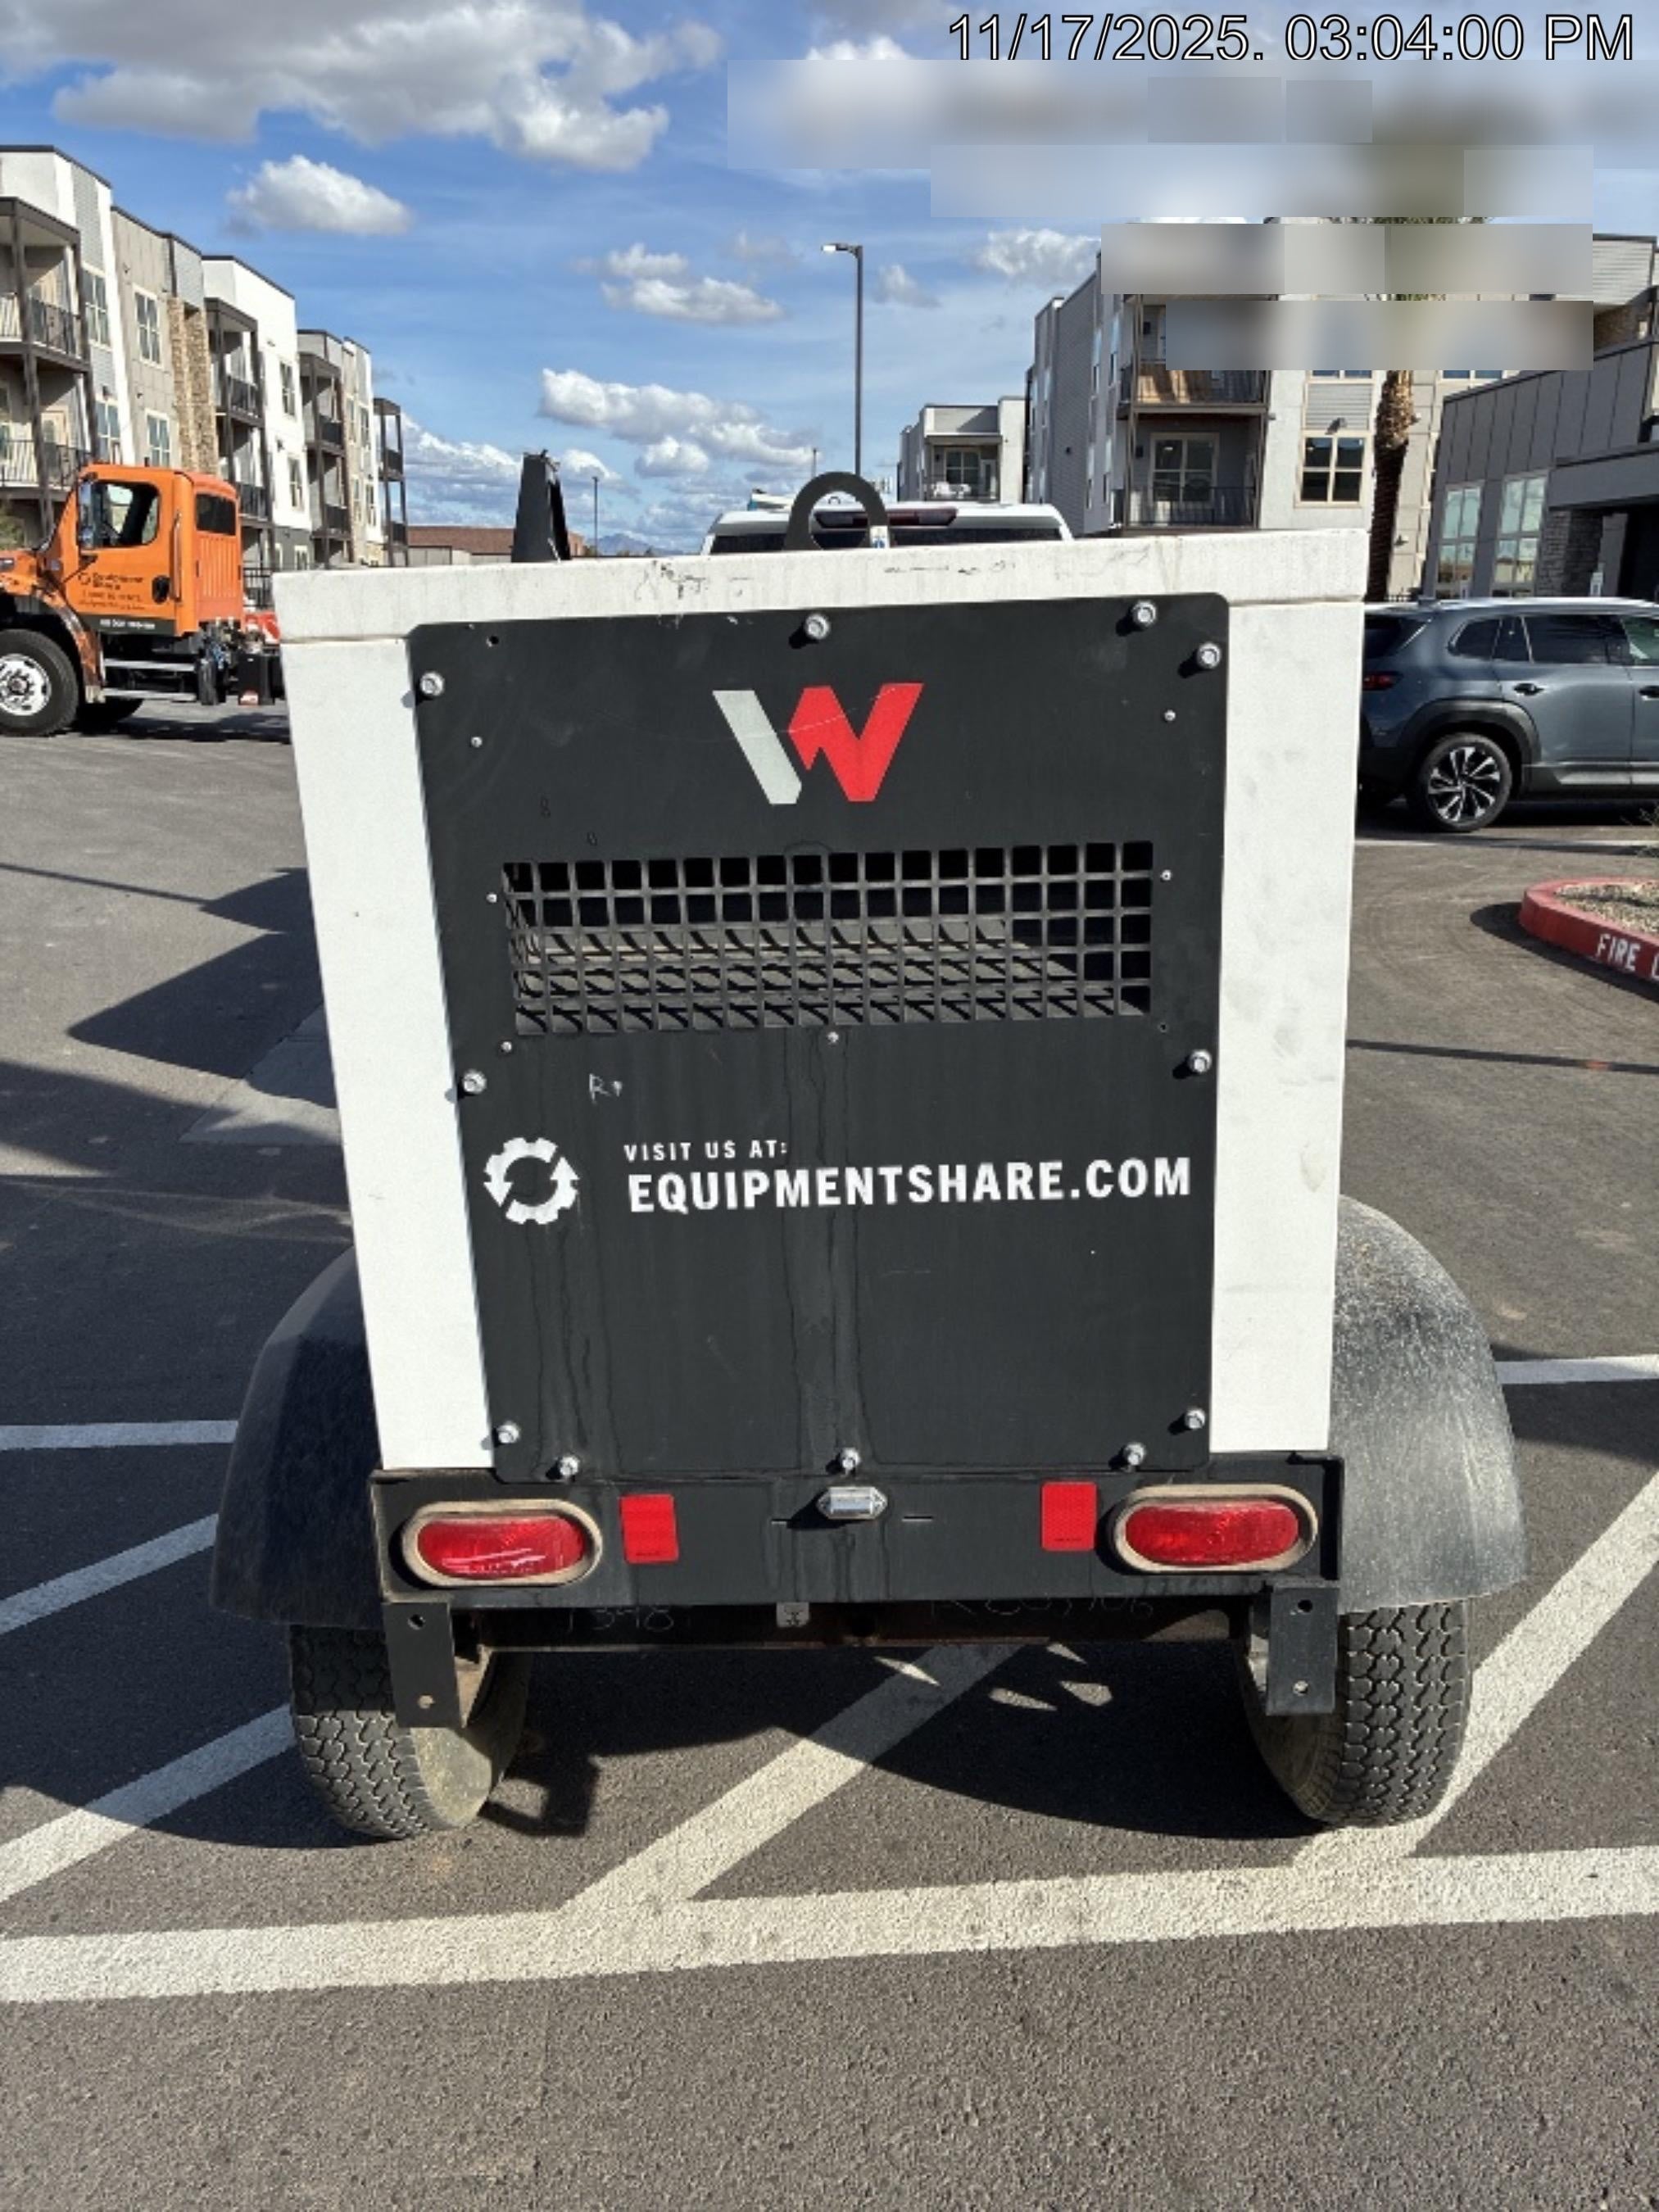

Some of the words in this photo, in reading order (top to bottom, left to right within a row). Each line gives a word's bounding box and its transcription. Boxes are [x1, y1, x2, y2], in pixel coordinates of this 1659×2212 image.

[1597, 934, 1640, 971] FIRE
[623, 1142, 691, 1163] VISIT
[705, 1140, 736, 1159] US
[749, 1140, 787, 1158] AT:
[628, 1157, 1190, 1215] EQUIPMENTSHARE.COM
